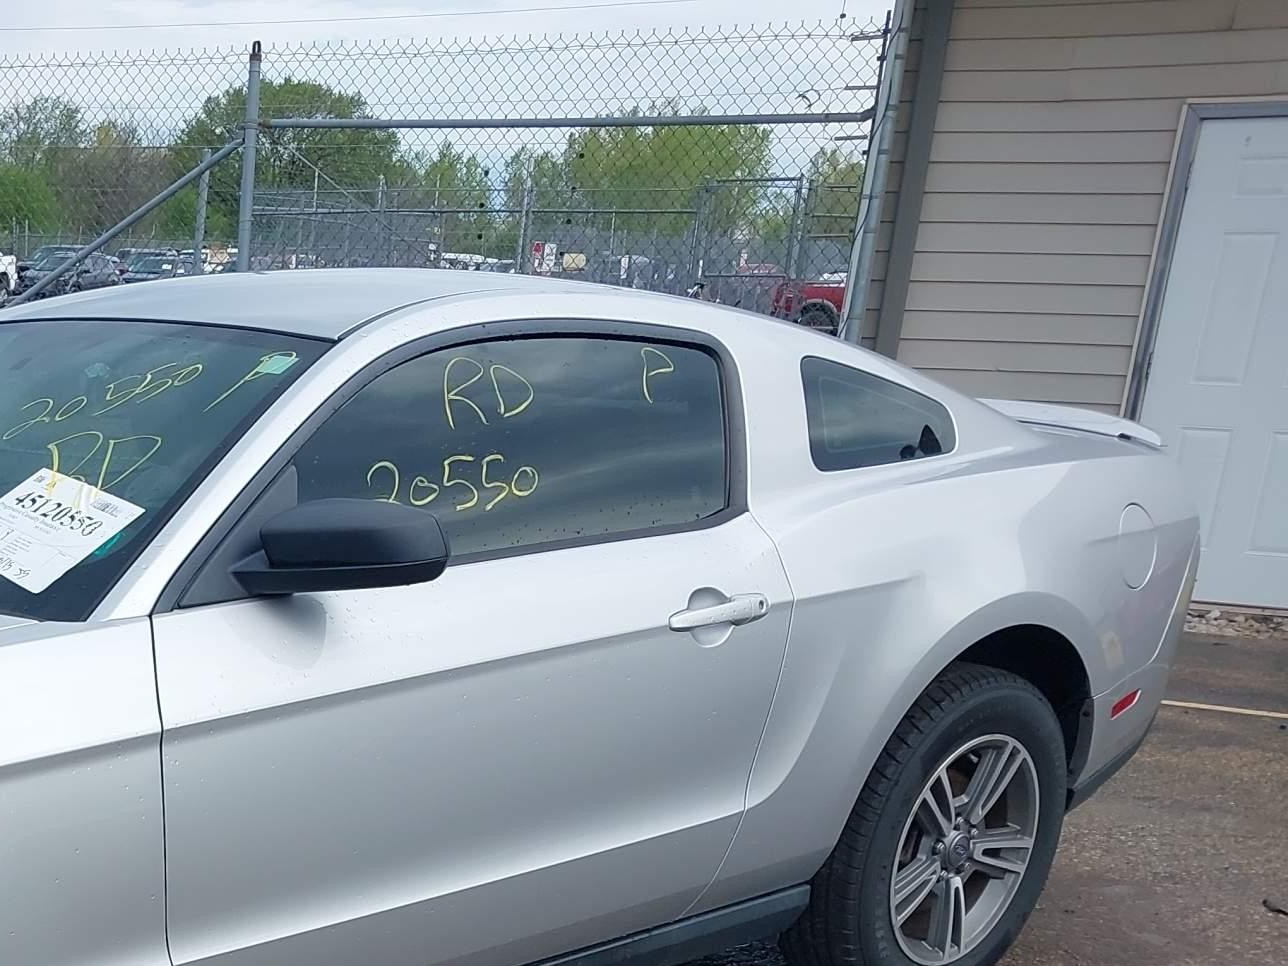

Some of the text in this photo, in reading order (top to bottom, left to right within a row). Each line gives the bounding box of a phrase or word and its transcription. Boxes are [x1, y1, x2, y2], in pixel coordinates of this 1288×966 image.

[2, 362, 203, 440] 20550
[443, 347, 674, 430] RD P
[14, 491, 103, 536] 45120550
[366, 453, 541, 512] 20550
